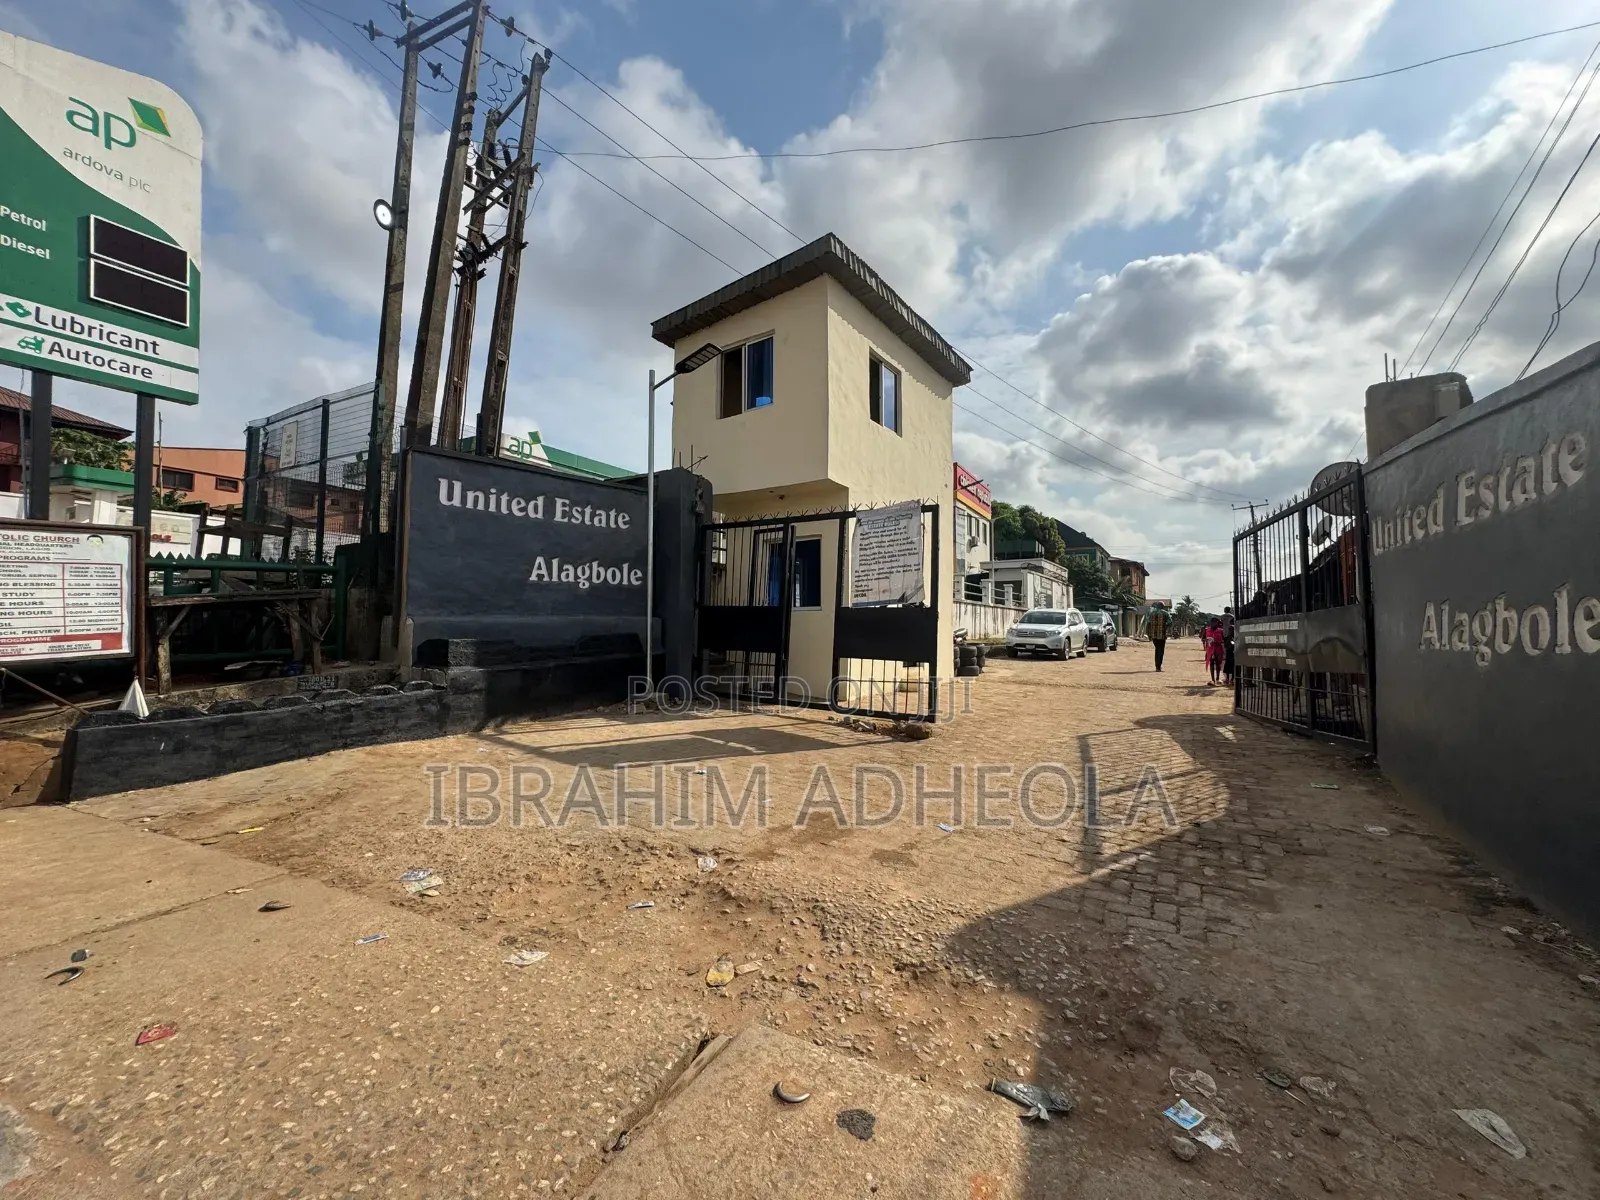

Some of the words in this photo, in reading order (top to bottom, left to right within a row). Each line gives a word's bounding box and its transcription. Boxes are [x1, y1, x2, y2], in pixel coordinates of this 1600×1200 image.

[65, 96, 137, 150] ap
[62, 147, 124, 182] ardova
[129, 176, 152, 194] plc
[0, 205, 47, 231] Petrol
[0, 234, 51, 260] Diesel
[34, 305, 160, 355] Lubricant
[48, 341, 153, 379] Autocare
[508, 436, 533, 460] ap
[438, 477, 545, 519] United
[554, 497, 631, 530] Estate
[1371, 481, 1445, 556] United
[1455, 431, 1587, 527] Estate
[33, 535, 80, 543] CHURCH
[529, 556, 643, 589] Alagbole
[1419, 582, 1600, 668] Alagbole
